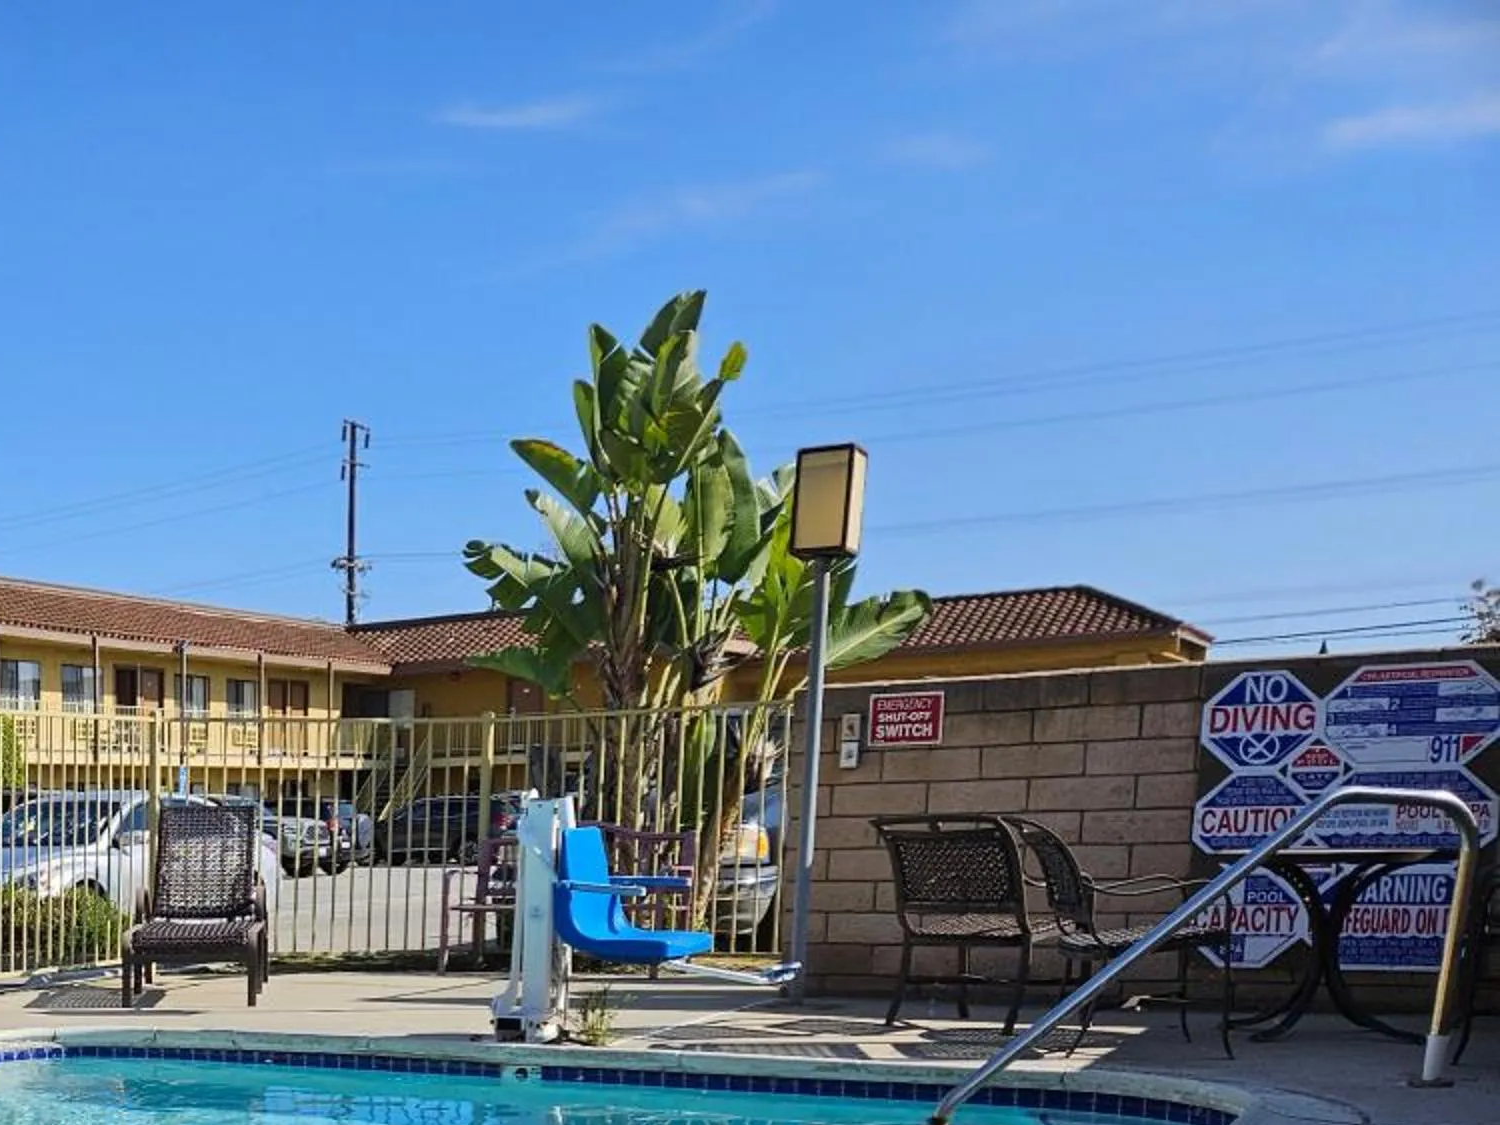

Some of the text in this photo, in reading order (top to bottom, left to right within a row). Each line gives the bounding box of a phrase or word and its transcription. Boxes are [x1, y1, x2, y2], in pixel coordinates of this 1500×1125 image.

[1245, 675, 1288, 703] NO
[875, 723, 933, 739] SWITCH
[877, 711, 932, 723] SHUT-OFF
[1209, 703, 1316, 734] DIVING
[1429, 735, 1460, 764] 911
[1200, 808, 1298, 835] CAUTIO
[1246, 891, 1285, 903] POOL
[1356, 875, 1447, 903] ARNING
[1345, 907, 1411, 934] FEGUARD
[1415, 907, 1438, 935] ON
